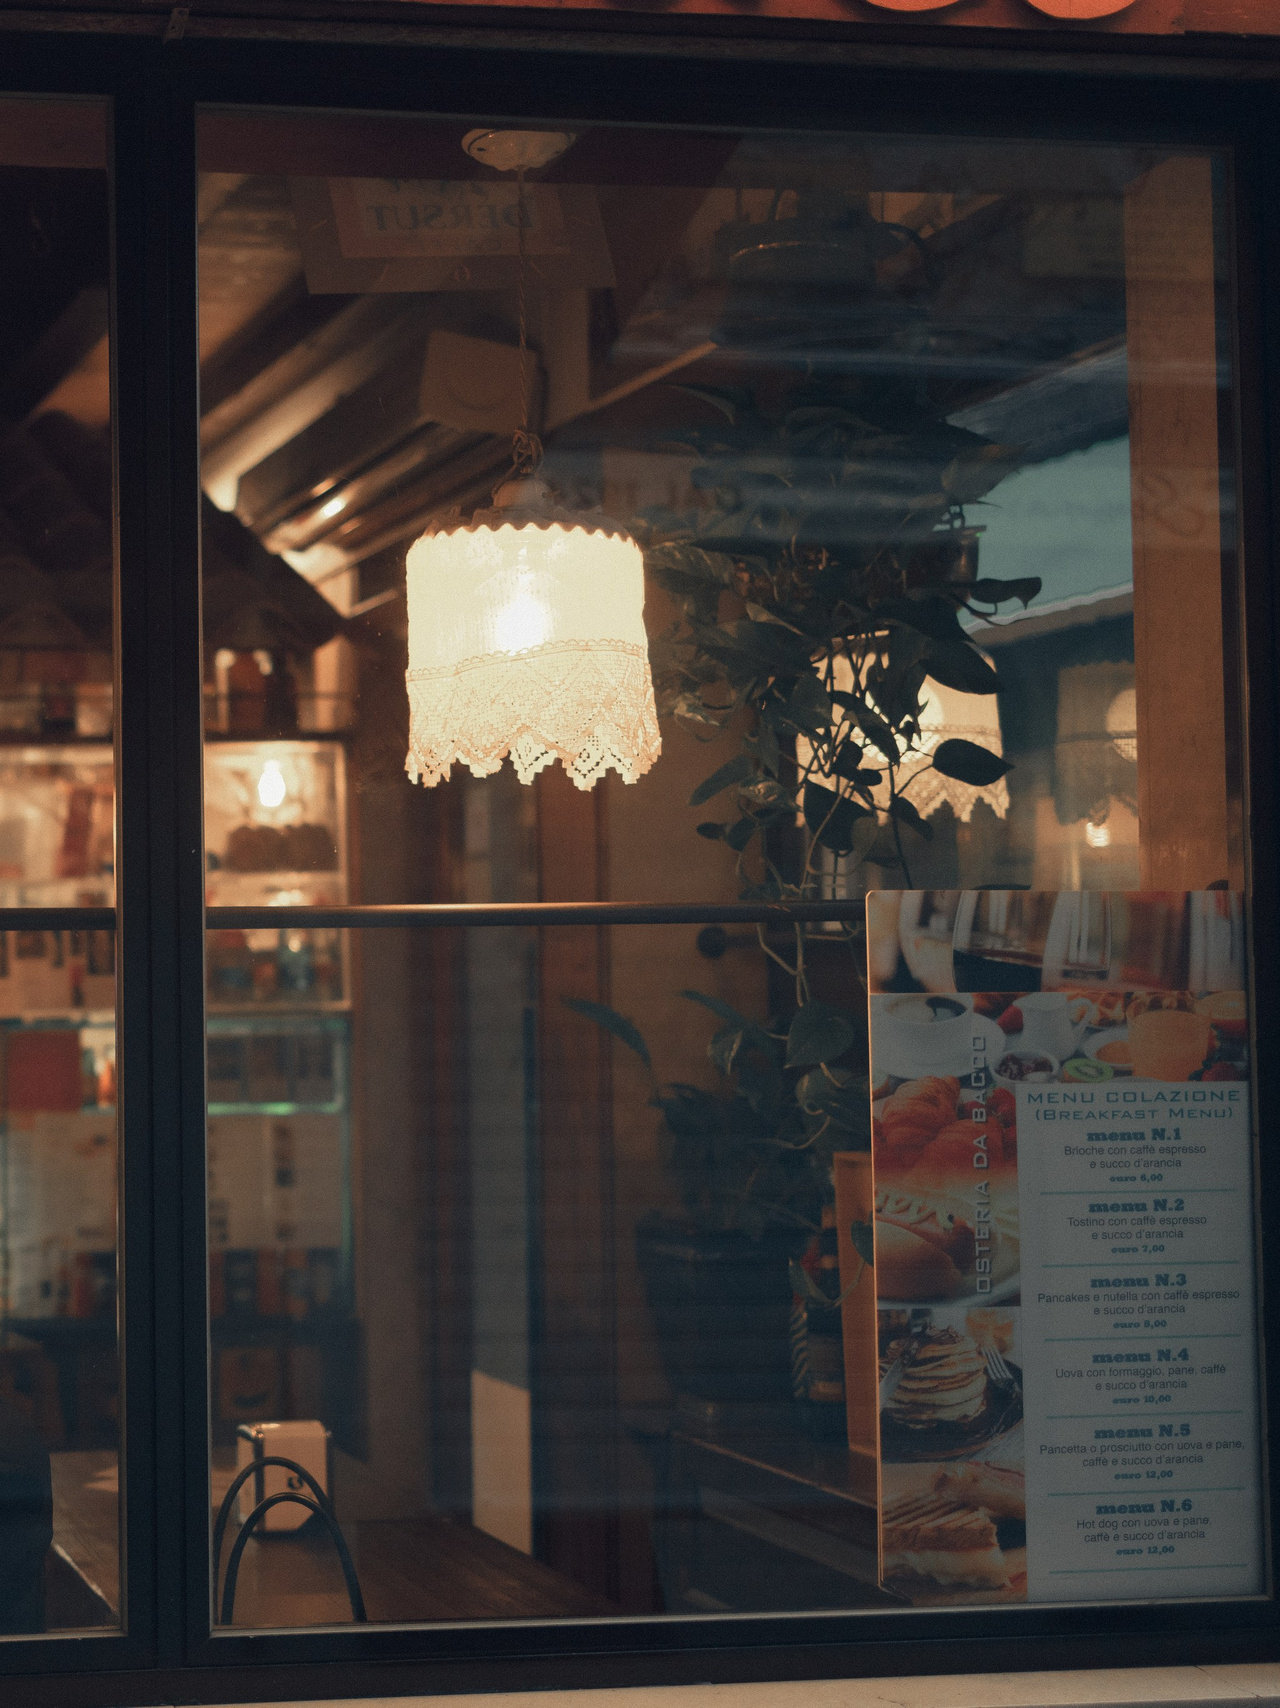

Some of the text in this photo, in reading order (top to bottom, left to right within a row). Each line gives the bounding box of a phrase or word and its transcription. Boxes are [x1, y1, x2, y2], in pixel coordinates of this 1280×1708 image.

[1027, 1089, 1240, 1104] MENU COLAZIONE
[1035, 1108, 1233, 1121] (BREAKFAST MENU)
[1087, 1128, 1181, 1141] menu N.1
[1064, 1145, 1206, 1155] Brioche con caffè espresso
[971, 1036, 992, 1294] OSTERIA DA BACCO
[1100, 1160, 1130, 1168] succo
[1140, 1174, 1163, 1182] 6,00
[1089, 1199, 1185, 1212] menu N.2
[1068, 1217, 1105, 1227] Tostino
[1131, 1216, 1156, 1225] caffè
[1159, 1216, 1207, 1227] espresso
[1092, 1232, 1099, 1240] e
[1102, 1231, 1132, 1239] succo
[1142, 1245, 1165, 1253] 7,00
[1091, 1274, 1187, 1288] menu N.3
[1038, 1293, 1090, 1302] Pancakes
[1104, 1292, 1138, 1301] nutella
[1164, 1291, 1188, 1300] caffè
[1193, 1290, 1239, 1301] espresso
[1104, 1306, 1134, 1314] succo
[1092, 1348, 1189, 1363] menu N.4
[1056, 1369, 1083, 1378] Uova
[1086, 1368, 1105, 1377] con
[1201, 1365, 1226, 1374] caffè
[1095, 1383, 1102, 1391] e
[1105, 1382, 1136, 1391] succo
[1144, 1395, 1171, 1404] 10,00
[1095, 1424, 1190, 1439] menu N.5
[1040, 1445, 1087, 1455] Pancetta
[1090, 1446, 1098, 1454] o
[1101, 1443, 1151, 1455] prosciutto
[1155, 1443, 1174, 1451] con
[1177, 1443, 1202, 1451] uova
[1206, 1442, 1213, 1450] e
[1083, 1457, 1108, 1467] caffè
[1112, 1458, 1119, 1466] e
[1121, 1457, 1152, 1466] succo
[1146, 1470, 1173, 1480] 12,00
[1096, 1499, 1192, 1514] menu N.6
[1077, 1520, 1095, 1529] Hot
[1099, 1519, 1118, 1530] dog
[1122, 1520, 1140, 1528] con
[1144, 1519, 1170, 1527] uova
[1084, 1532, 1110, 1542] caffè
[1114, 1533, 1121, 1541] e
[1123, 1532, 1154, 1541] succo
[1148, 1546, 1174, 1555] 12,00
